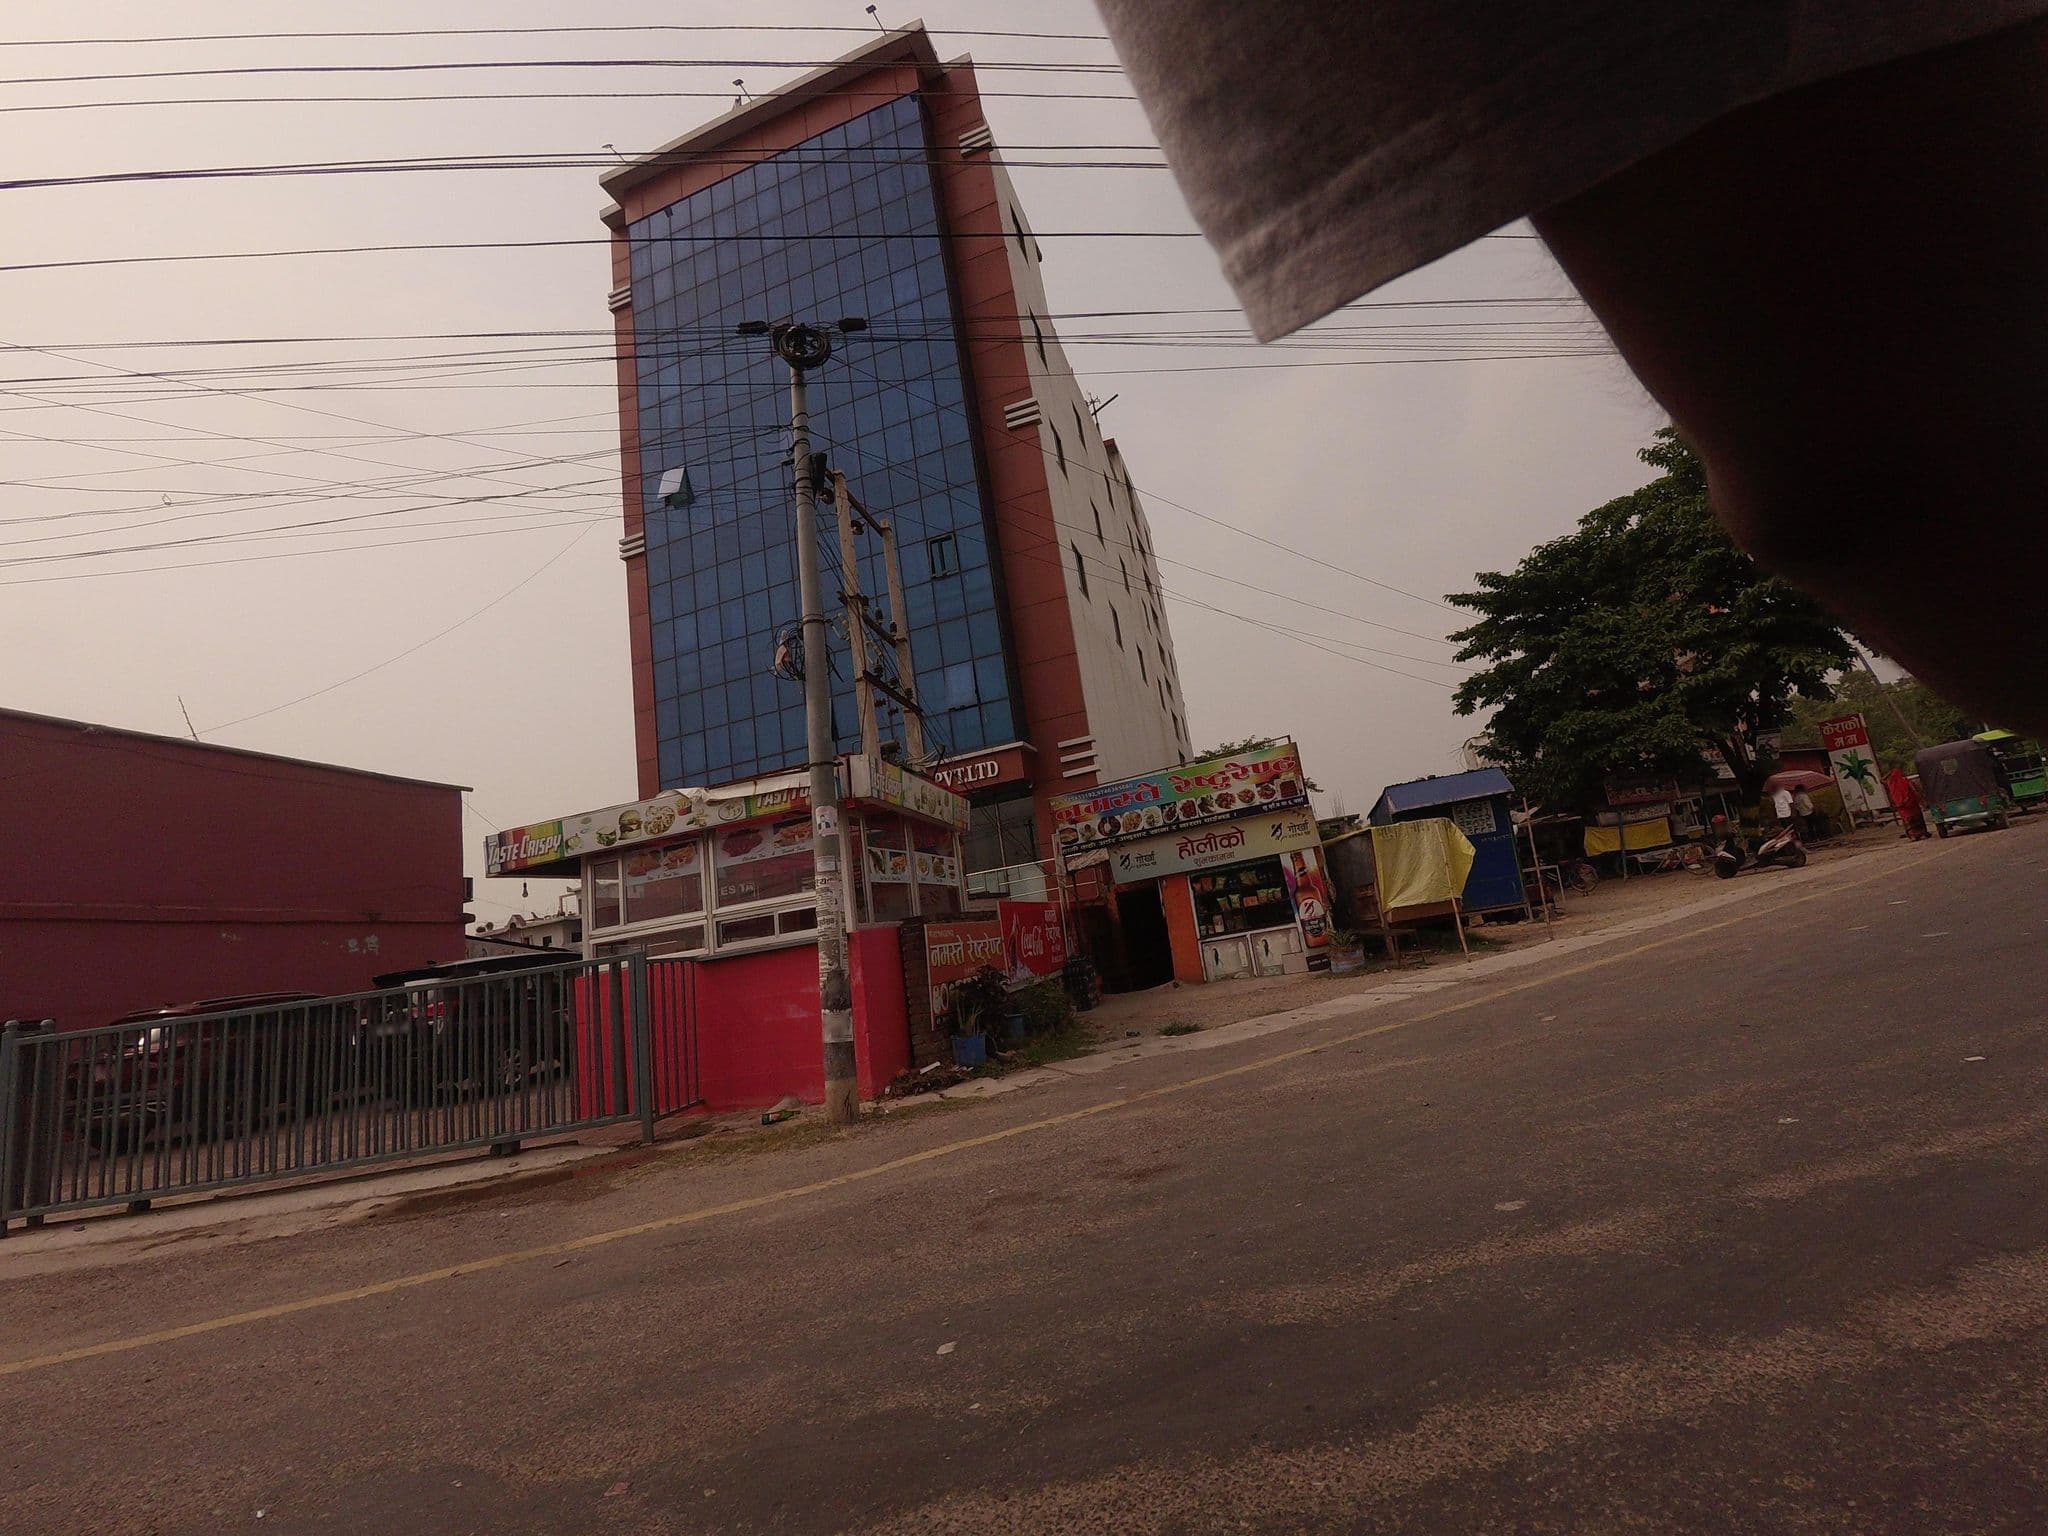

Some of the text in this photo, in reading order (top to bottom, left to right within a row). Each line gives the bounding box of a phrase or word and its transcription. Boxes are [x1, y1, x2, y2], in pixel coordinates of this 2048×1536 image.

[1822, 718, 1861, 738] केराको
[1055, 782, 1161, 820] नमस्ते
[486, 834, 563, 867] TASTE CRISPY
[1176, 826, 1246, 861] होलीको
[929, 934, 965, 967] नमस्ते
